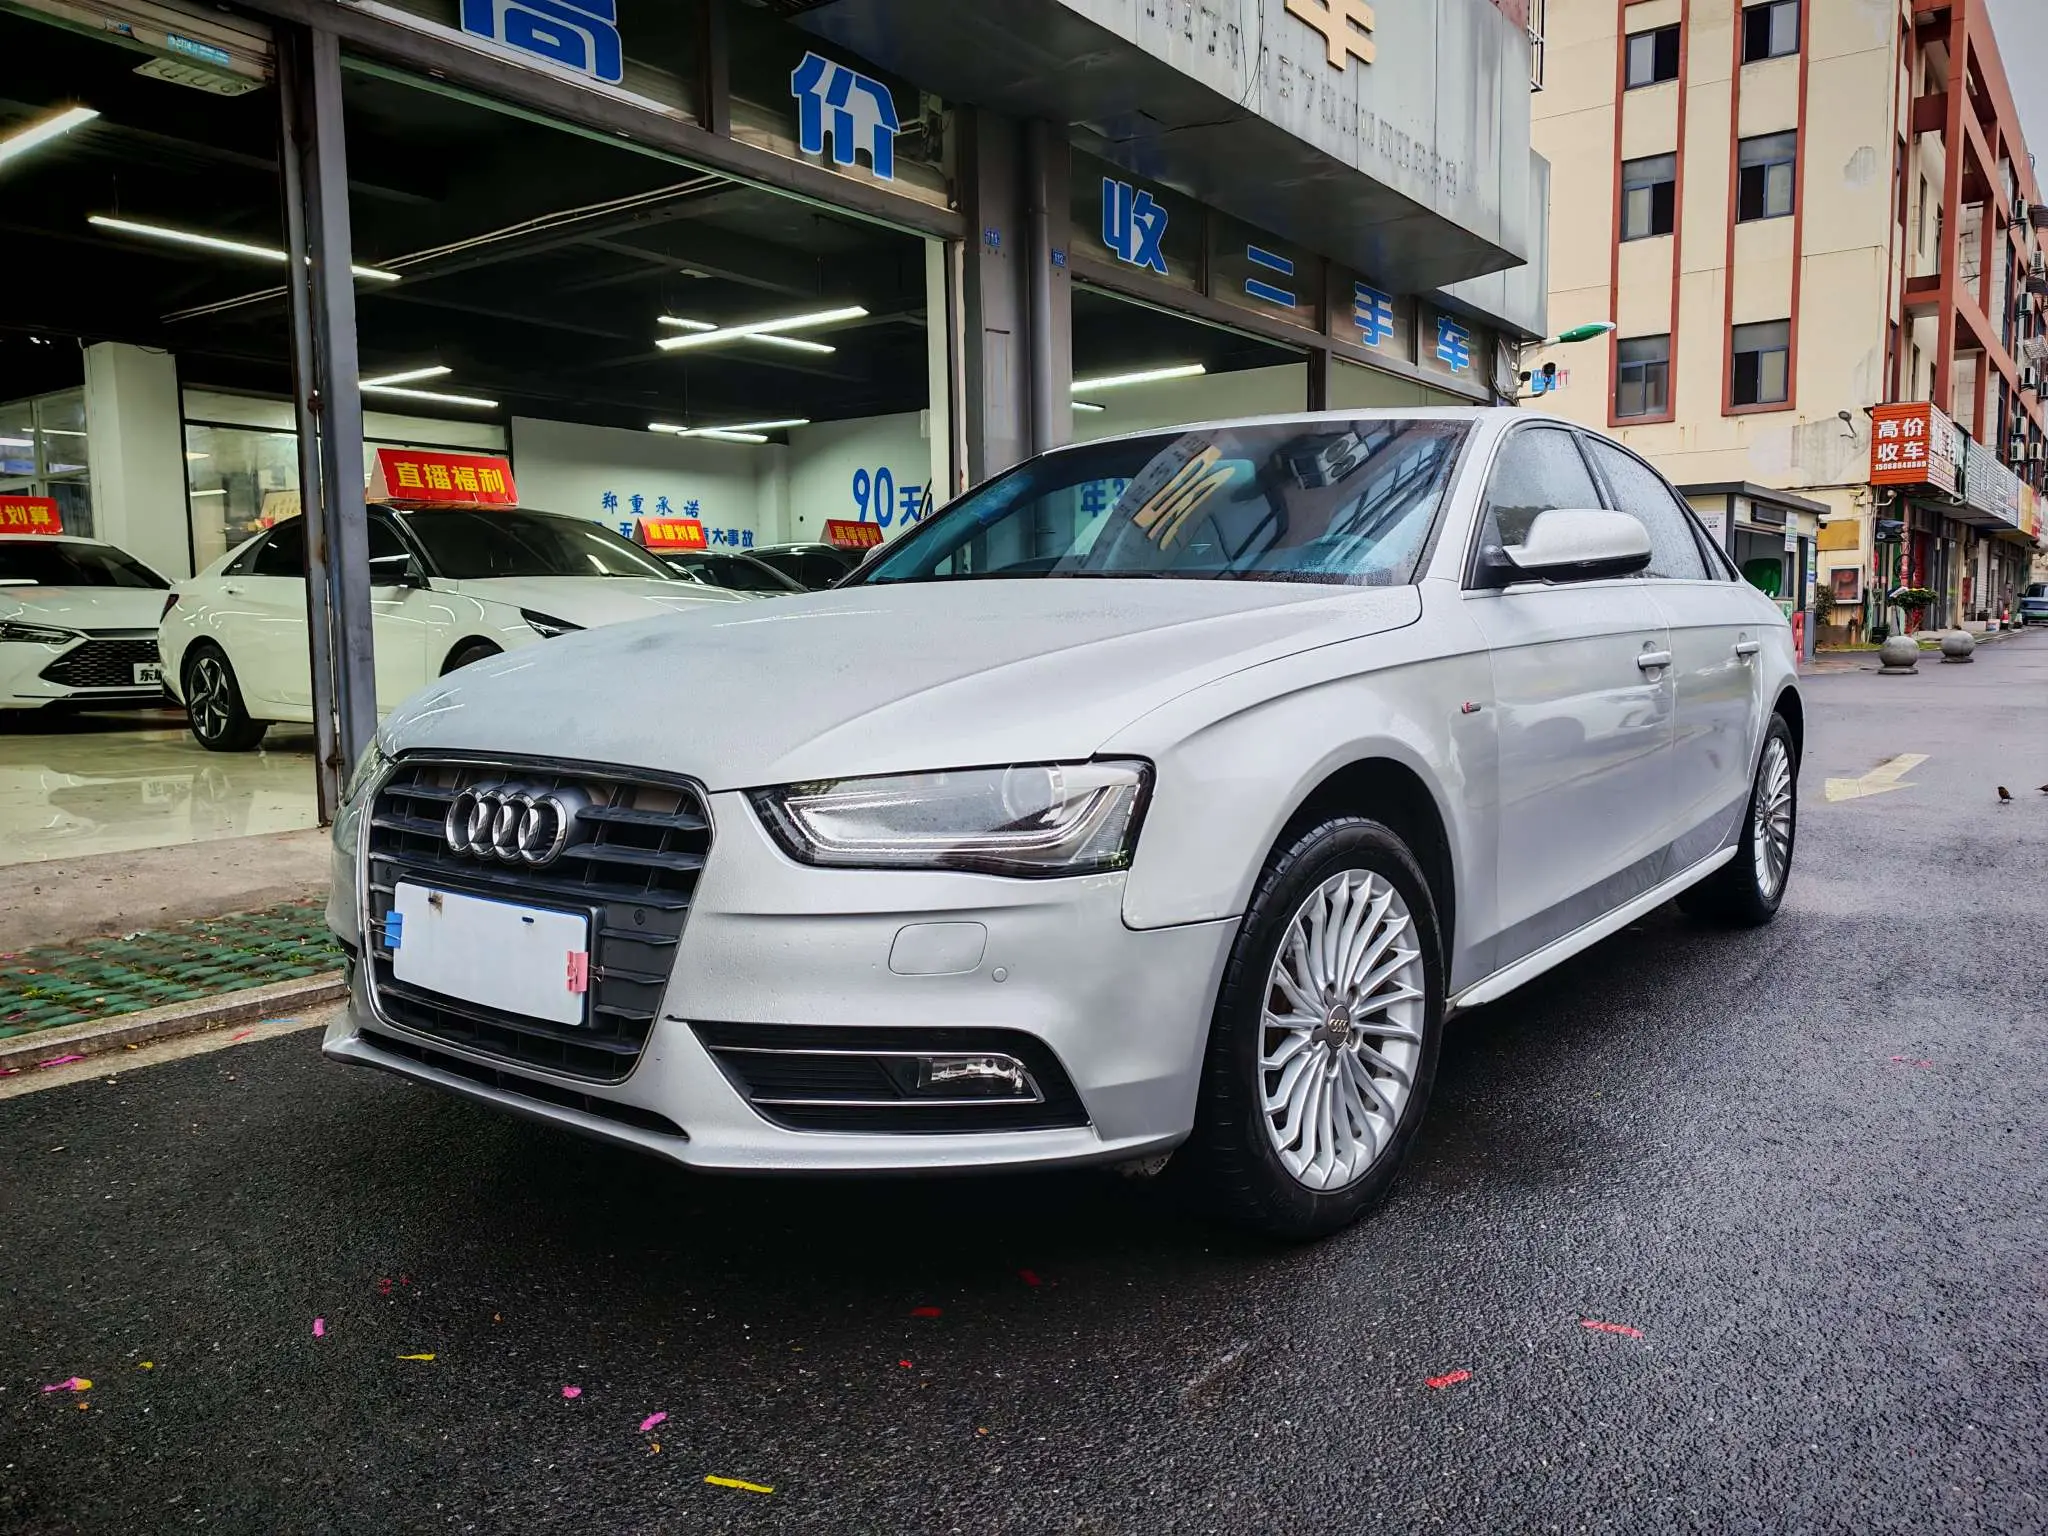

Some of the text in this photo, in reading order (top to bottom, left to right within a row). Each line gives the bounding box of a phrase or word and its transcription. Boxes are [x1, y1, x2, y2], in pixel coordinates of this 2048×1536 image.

[1878, 417, 1924, 438] 高价
[1878, 441, 1924, 462] 收车
[394, 462, 505, 494] 直播福利
[602, 491, 700, 518] 郑重承诺
